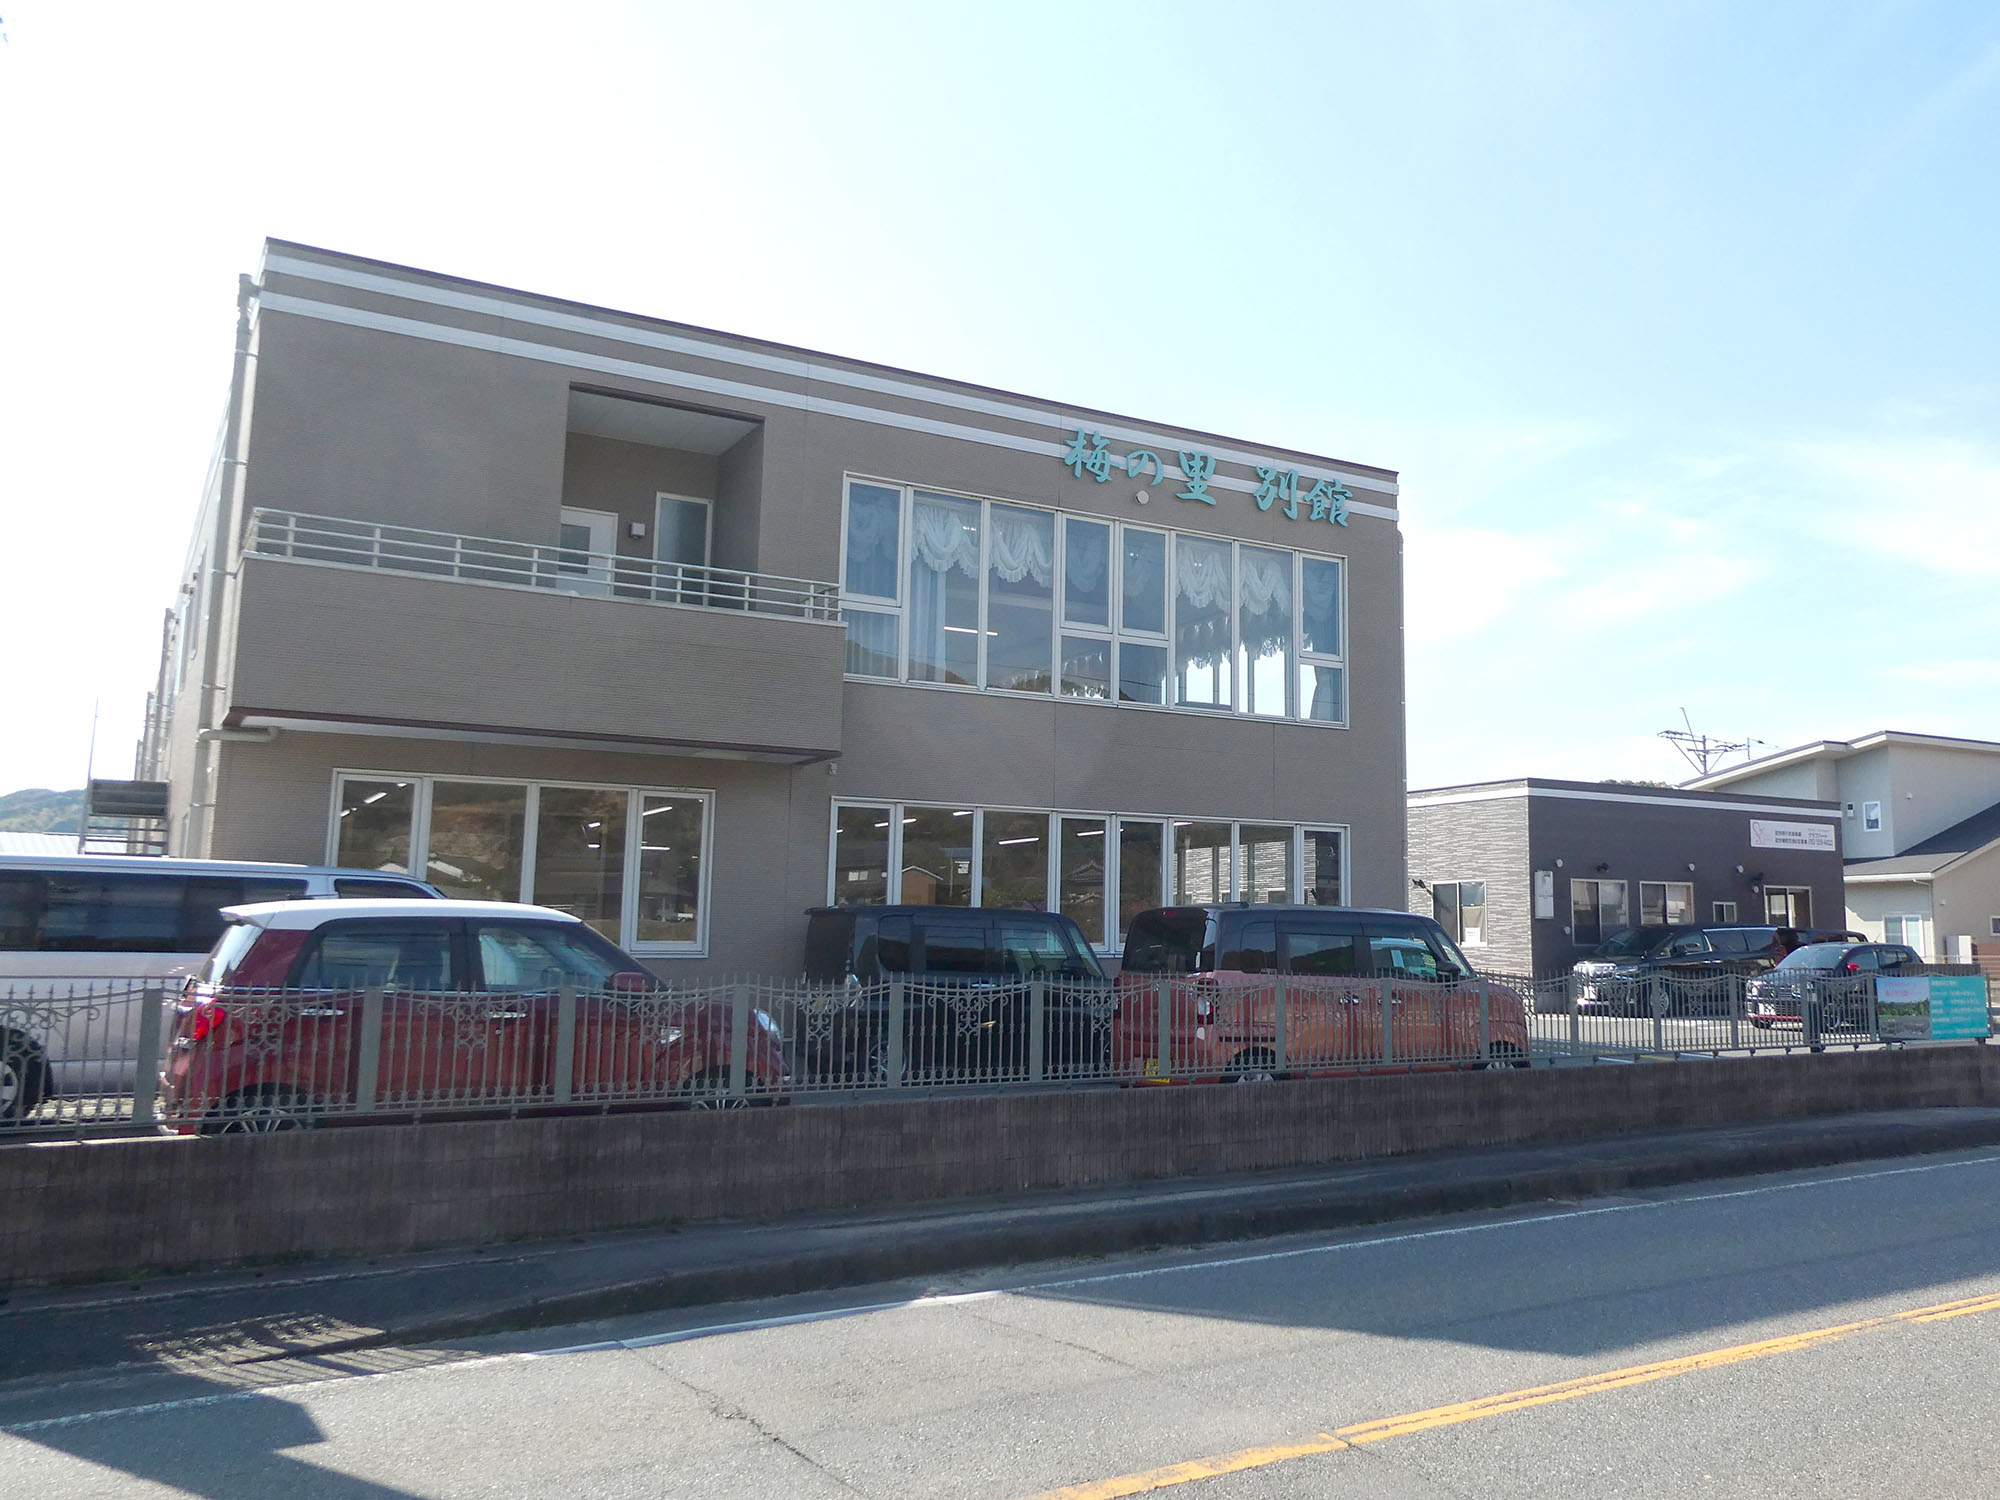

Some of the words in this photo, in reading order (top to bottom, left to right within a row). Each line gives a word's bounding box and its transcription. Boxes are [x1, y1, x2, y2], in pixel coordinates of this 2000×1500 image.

[1064, 427, 1217, 506] 梅の里
[1253, 465, 1353, 527] 別館
